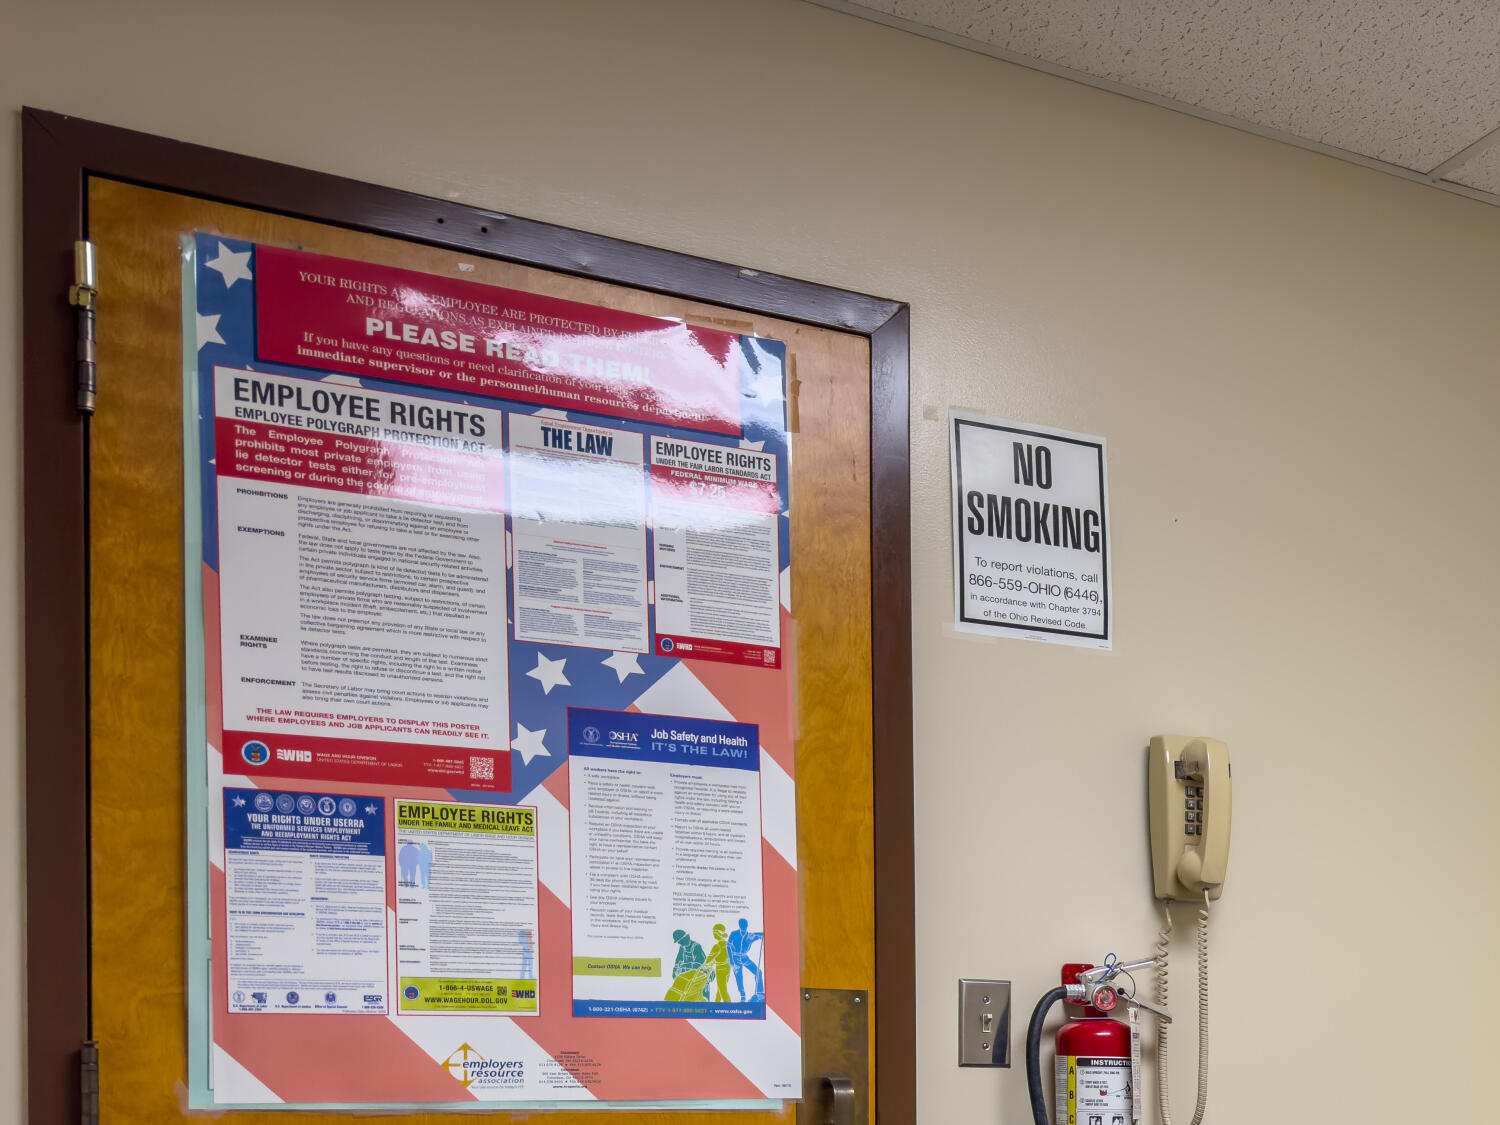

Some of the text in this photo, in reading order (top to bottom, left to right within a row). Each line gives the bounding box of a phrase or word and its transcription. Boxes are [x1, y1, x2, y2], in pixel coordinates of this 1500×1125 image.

[299, 271, 336, 287] YOUR
[339, 279, 388, 296] RIGHTS
[431, 293, 498, 315] EMPLOYEE
[502, 308, 526, 321] ARE
[529, 312, 600, 337] PROTECTED
[603, 327, 620, 338] BY
[346, 293, 374, 307] AND
[469, 315, 485, 328] AS
[365, 317, 476, 353] PLEASE
[486, 338, 561, 368] READ
[568, 352, 651, 385] THEM!
[304, 331, 316, 343] If
[316, 335, 339, 348] you
[341, 338, 369, 352] have
[372, 345, 392, 358] any
[395, 350, 450, 367] questions
[453, 359, 466, 368] or
[468, 361, 494, 374] need
[497, 366, 563, 386] clarification
[565, 376, 578, 387] of
[578, 381, 602, 394] your
[297, 344, 364, 366] immediate
[368, 361, 435, 379] supervisor
[438, 370, 453, 380] or
[455, 372, 477, 385] the
[480, 376, 581, 402] personnel/human
[584, 394, 639, 411] resources
[234, 377, 486, 437] EMPLOYEE RIGHTS
[235, 406, 485, 453] EMPLOYEE POLYGRAPH PROTECTION ACT
[235, 424, 256, 436] The
[268, 429, 323, 447] Employee
[335, 440, 390, 456] Polygraph
[541, 426, 573, 451] THE
[576, 431, 613, 457] LAW
[235, 438, 285, 454] prohibits
[290, 446, 319, 458] most
[324, 451, 362, 467] private
[656, 441, 722, 465] EMPLOYEE
[726, 452, 772, 472] RIGHTS
[235, 449, 249, 460] lie
[254, 453, 303, 468] detector
[309, 460, 336, 473] tests
[341, 465, 373, 478] either
[378, 467, 395, 480] for
[655, 457, 772, 481] UNDER THE FAIR LABOR STANDARDS ACT
[670, 469, 703, 480] FEDERAL
[1013, 441, 1053, 490] NO
[236, 464, 292, 480] screening
[294, 471, 306, 480] or
[308, 472, 344, 487] during
[346, 475, 363, 487] the
[236, 487, 289, 500] PROHIBITIONS
[237, 526, 285, 537] EXEMPTIONS
[967, 490, 1101, 553] SMOKING
[975, 556, 1099, 584] To report violations, call
[969, 573, 1103, 605] 866-559-OHIO (6446),
[970, 592, 1102, 617] in accordance with Chapter 3794
[983, 610, 1088, 630] of the Ohio Revised Code.
[240, 634, 278, 643] EXAMINEE
[240, 641, 267, 649] RIGHTS
[241, 676, 296, 687] ENFORCEMENT
[246, 714, 276, 724] WHERE
[278, 717, 327, 728] EMPLOYEES
[328, 720, 345, 729] AND
[347, 722, 363, 730] JOB
[364, 723, 413, 734] APPLICANTS
[414, 727, 431, 735] CAN
[432, 729, 463, 738] READILY
[464, 731, 480, 739] SEE
[256, 707, 480, 731] THE LAW REQUIRES EMPLOYERS TO DISPLAY THIS POSTER
[609, 731, 640, 743] OSHA
[650, 729, 748, 747] Job Safety and Health
[284, 749, 313, 763] WHD
[651, 741, 677, 752] IT'S
[679, 745, 709, 756] THE
[712, 748, 748, 759] LAW!
[247, 813, 365, 829] YOUR RIGHTS UNDER USERRA
[398, 818, 534, 834] UNDER THE FAMILY AND MEDICAL LEAVE ACT
[399, 805, 534, 826] EMPLOYEE RIGHTS
[251, 822, 262, 831] THE
[296, 825, 323, 834] SERVICES
[324, 827, 361, 836] EMPLOYMENT
[261, 830, 273, 838] AND
[275, 831, 320, 841] REEMPLOYMENT
[462, 1058, 524, 1070] employers
[470, 1068, 525, 1078] resource
[1069, 1066, 1075, 1075] A
[478, 1077, 525, 1085] association
[1069, 1090, 1075, 1100] B
[1069, 1114, 1075, 1124] C
